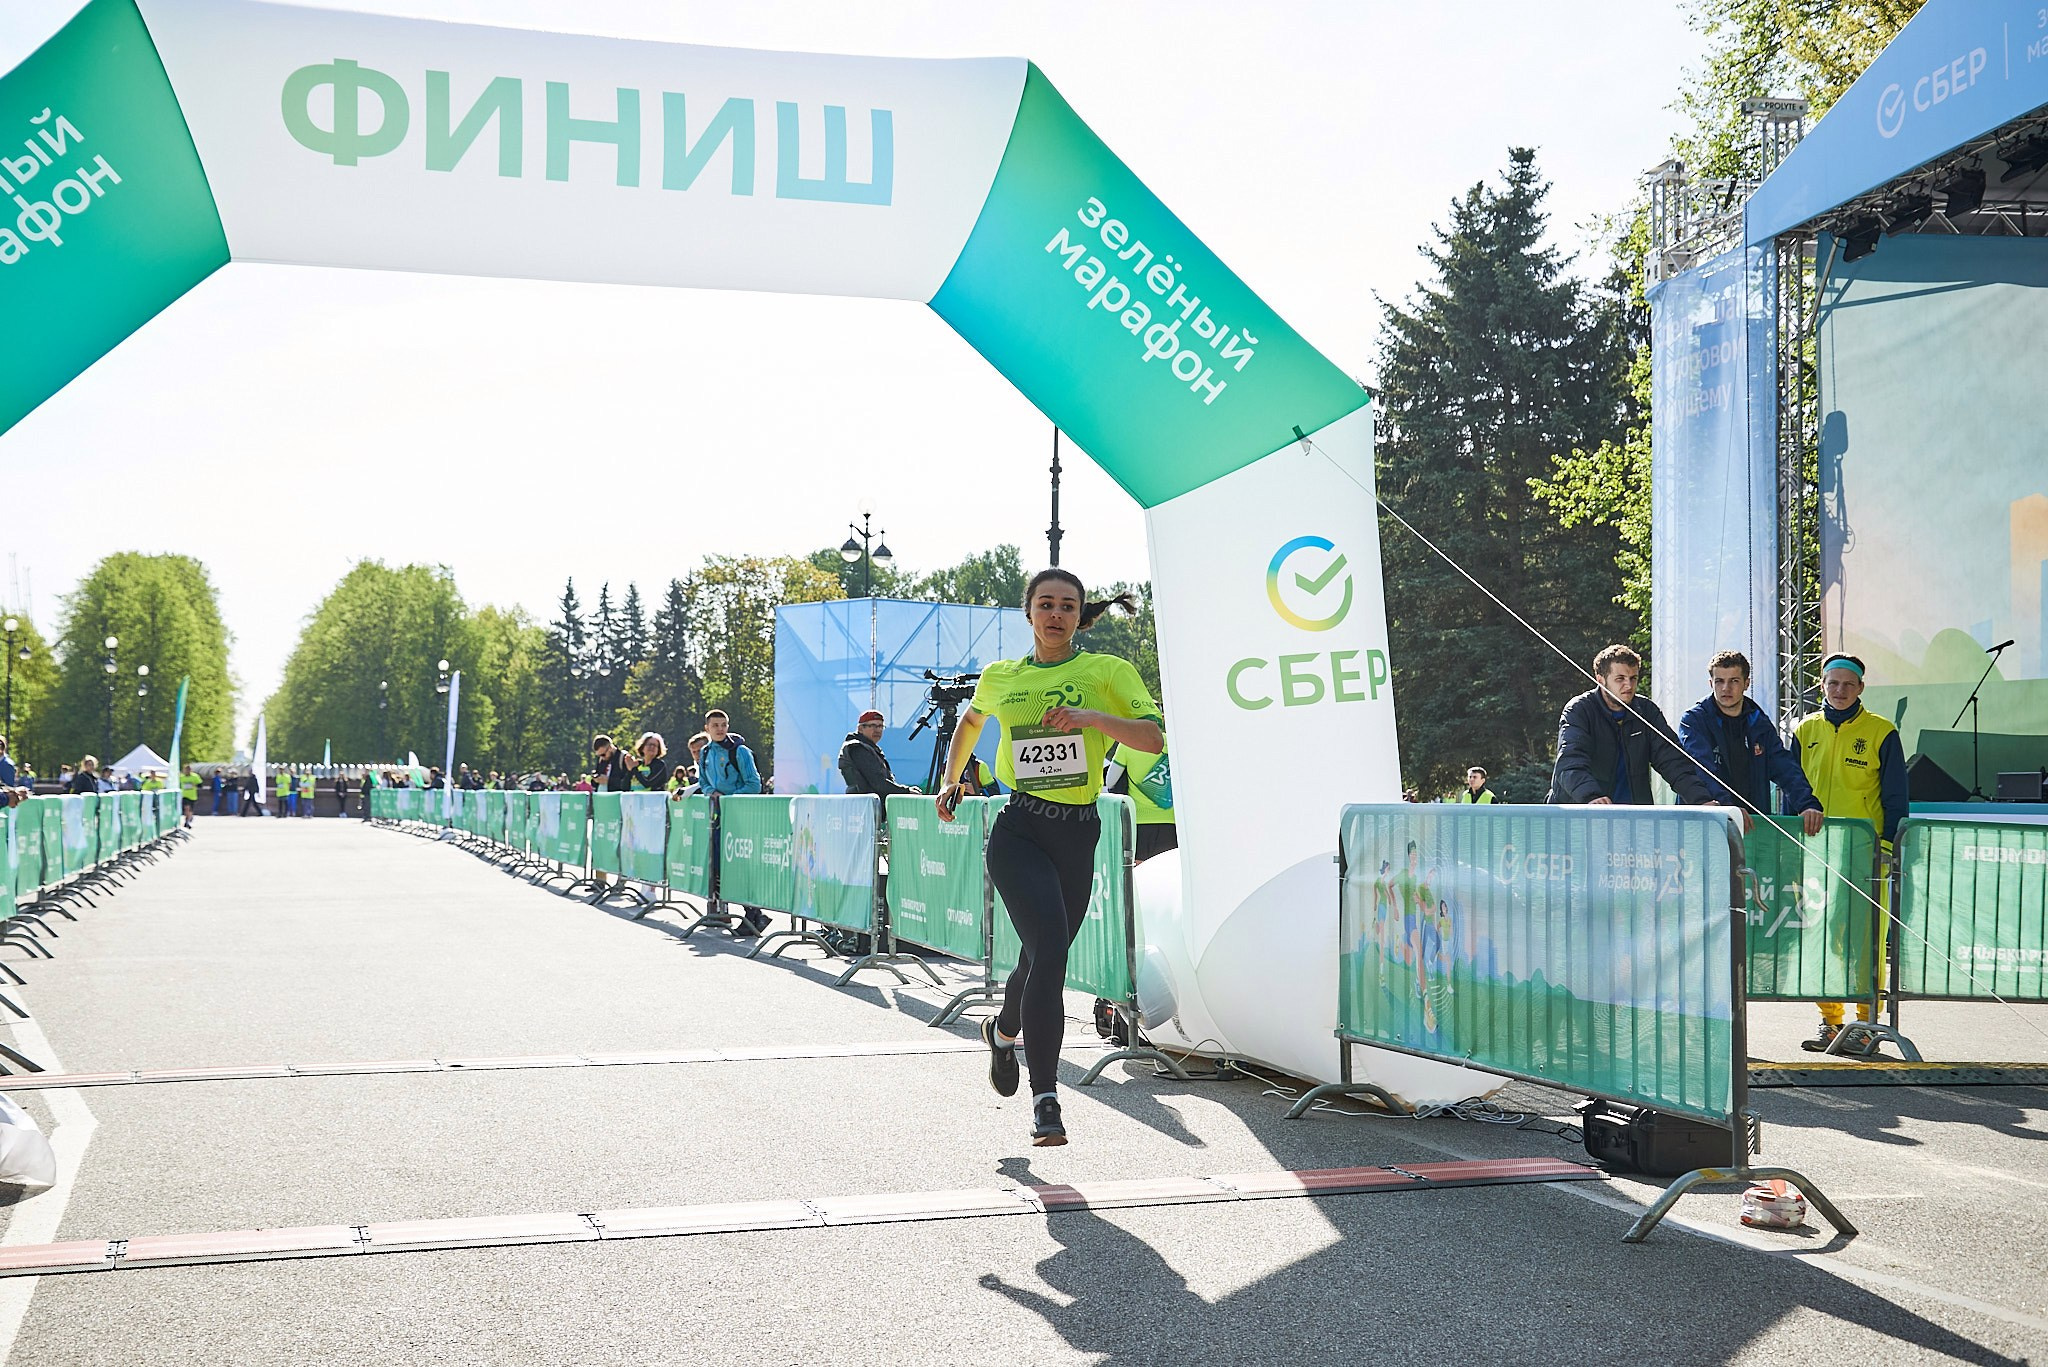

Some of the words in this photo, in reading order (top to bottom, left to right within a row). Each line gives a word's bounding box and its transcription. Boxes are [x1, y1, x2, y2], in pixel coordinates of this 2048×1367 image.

[1913, 47, 1987, 112] СБЕР
[1765, 101, 1796, 111] PROLYTE
[281, 58, 894, 206] ФИНИШ
[1077, 196, 1260, 373] зелёный
[1044, 227, 1227, 406] марафон
[1226, 649, 1388, 711] СБЕР
[1019, 742, 1078, 764] 42331
[1039, 766, 1053, 775] 4,2
[734, 838, 754, 859] СБЕР
[1607, 847, 1663, 869] зелёный
[1523, 851, 1575, 882] СБЕР
[1598, 873, 1658, 896] марафон
